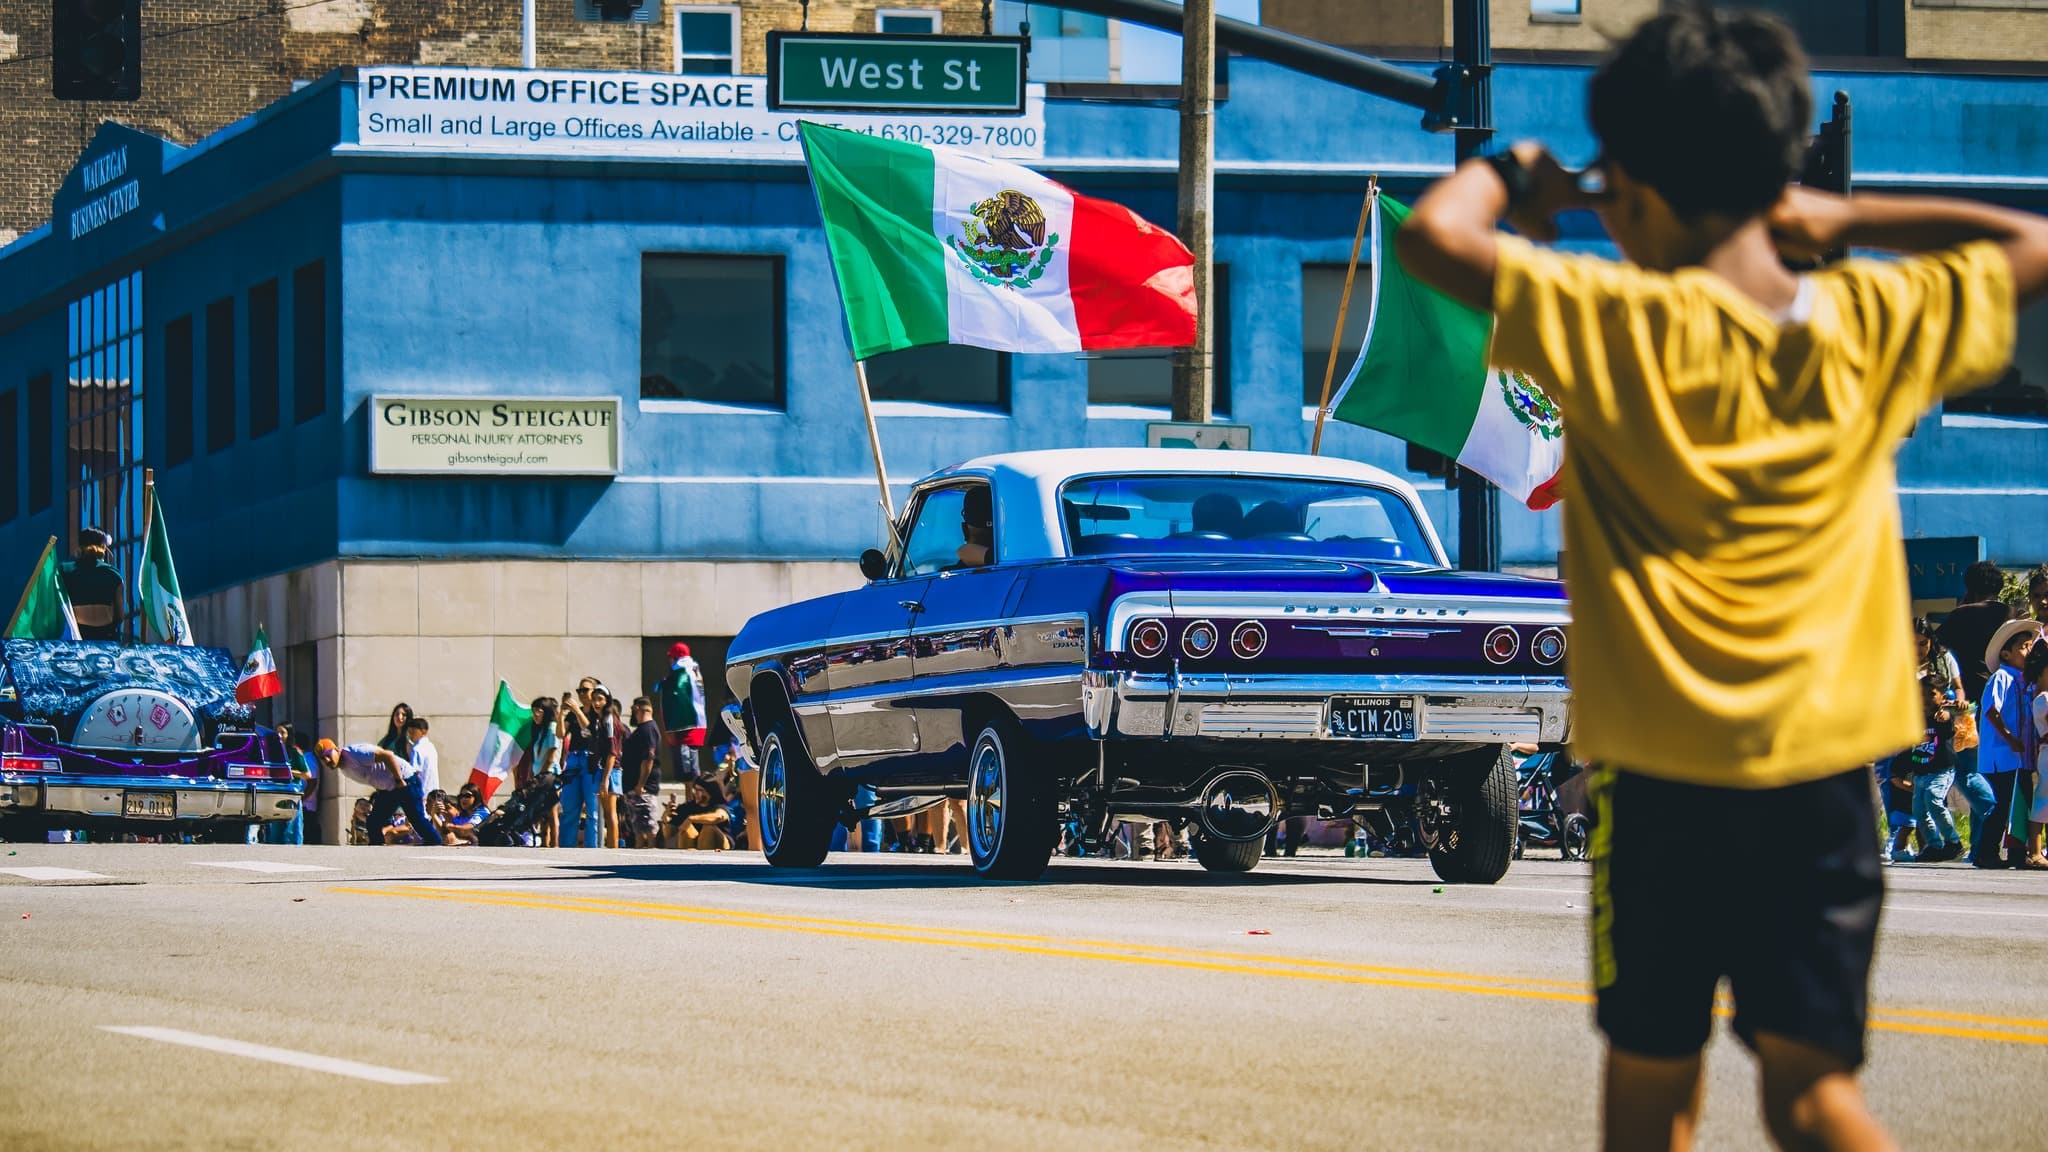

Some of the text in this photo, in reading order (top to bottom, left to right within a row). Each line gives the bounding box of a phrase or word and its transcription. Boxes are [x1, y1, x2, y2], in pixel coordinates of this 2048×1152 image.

[820, 56, 981, 91] West St
[368, 75, 754, 107] PREMIUM OFFICE SPACE
[368, 112, 432, 134] Small
[441, 115, 482, 135] and
[491, 115, 556, 142] Large
[565, 117, 643, 139] Offices
[651, 119, 754, 141] Available
[881, 124, 1036, 147] 630-329-7800
[83, 144, 127, 193] WAUKEGAN
[71, 179, 140, 241] BUSINESS CENTER
[384, 402, 481, 427] GIBSON
[411, 433, 584, 446] PERSONAL INJURY ATTORNEYS
[447, 452, 549, 467] gibsonsteigauf.com
[1353, 698, 1391, 707] ILLINOIS
[1347, 709, 1402, 732] CTM 20
